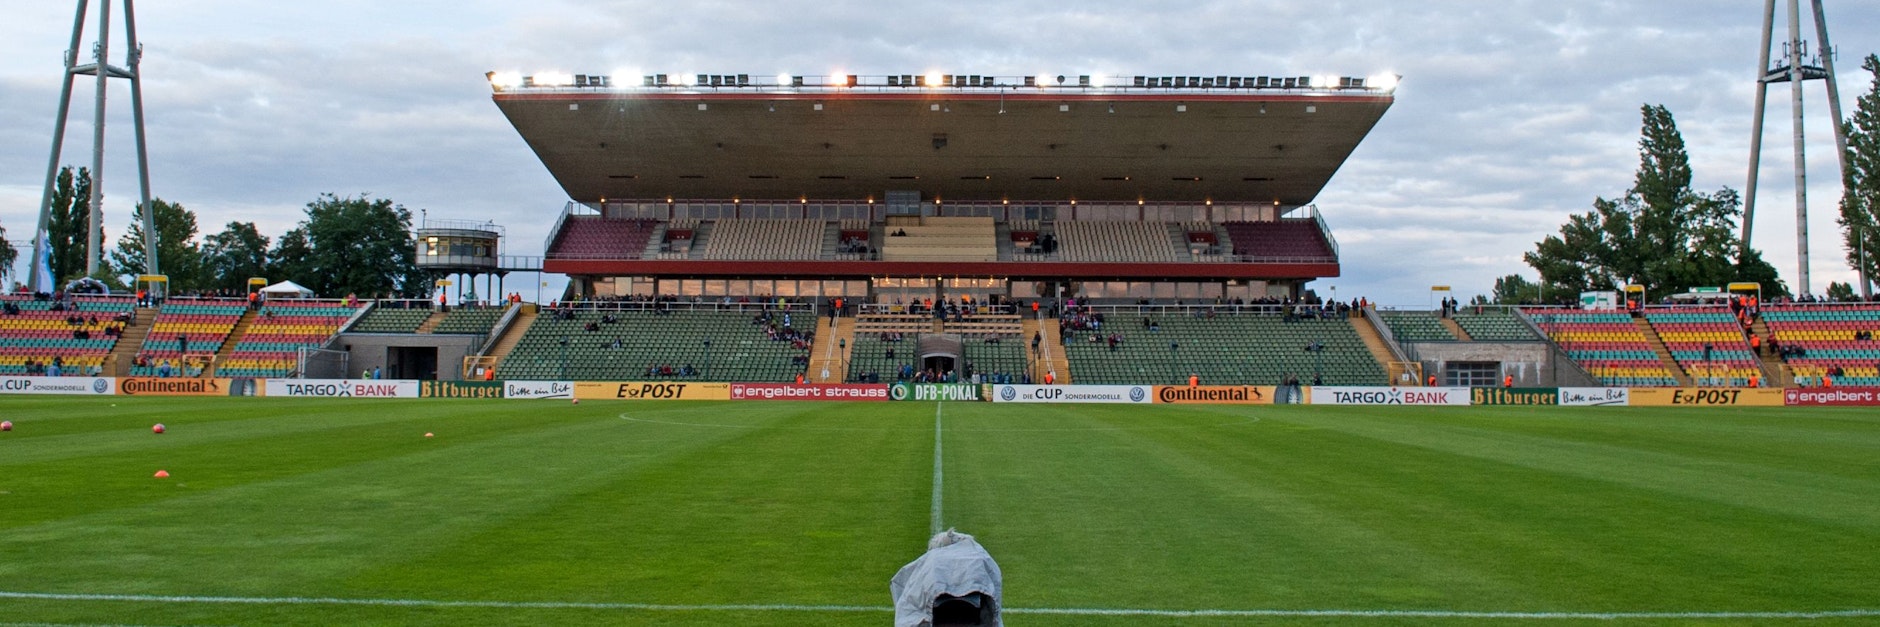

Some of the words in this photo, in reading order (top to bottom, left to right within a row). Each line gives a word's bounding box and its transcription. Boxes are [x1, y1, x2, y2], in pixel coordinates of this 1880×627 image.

[5, 379, 32, 391] CUP
[121, 378, 205, 395] Continental
[286, 384, 337, 396] TARGO
[355, 384, 397, 397] BANK
[420, 381, 502, 399] Bitburger
[508, 384, 531, 397] Bitte
[534, 387, 549, 395] ein
[551, 382, 571, 394] Bit
[745, 385, 822, 398] engelbert
[825, 386, 888, 398] strauss
[915, 384, 979, 401] DFB-POKAL
[1035, 387, 1063, 400] CUP
[1159, 386, 1249, 403] Continental
[1333, 391, 1386, 404] TARGO
[1405, 392, 1448, 404] BANK
[1473, 388, 1556, 405] Bitburger
[1562, 391, 1584, 404] Bitte
[1588, 394, 1604, 402] ein
[1605, 388, 1625, 401] Bit
[1799, 390, 1872, 403] engelbert
